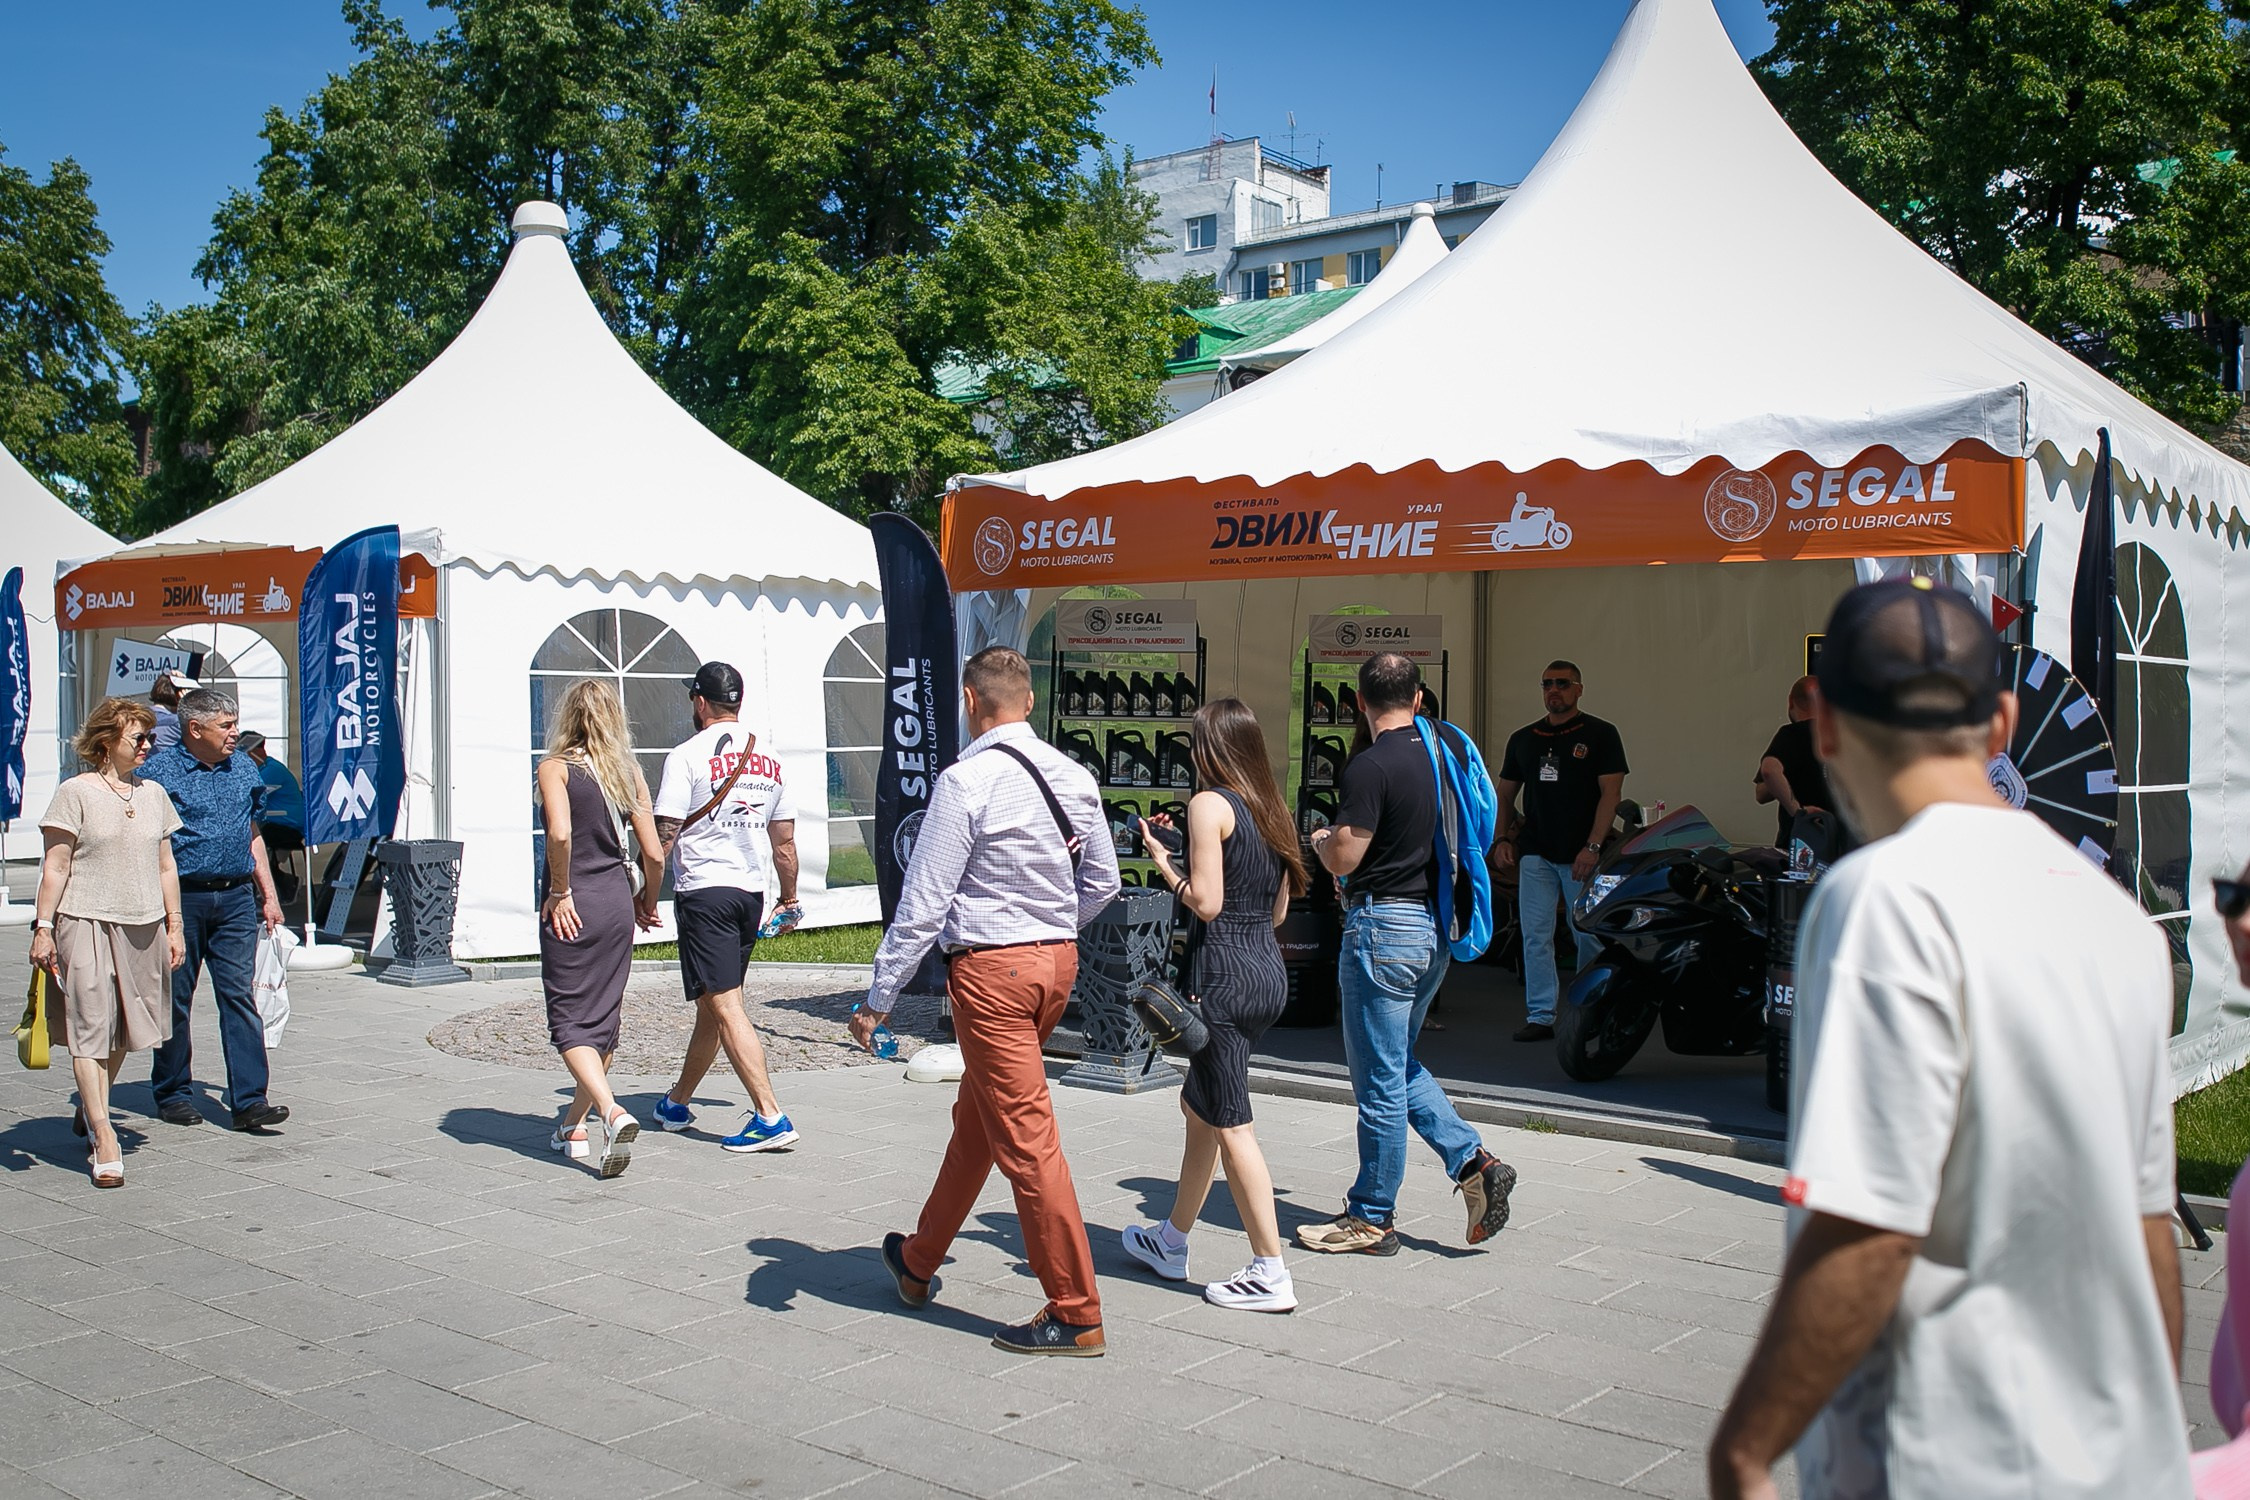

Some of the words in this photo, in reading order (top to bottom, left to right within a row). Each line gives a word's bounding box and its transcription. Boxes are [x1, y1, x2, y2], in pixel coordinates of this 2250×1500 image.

[1785, 463, 1956, 510] SEGAL
[1213, 498, 1280, 510] ФЕСТИВАЛЬ
[1407, 503, 1443, 514] УРАЛ
[1788, 516, 1839, 532] MOTO
[1842, 512, 1952, 530] LUBRICANTS
[1019, 516, 1116, 550] SEGAL
[1020, 556, 1050, 568] MOTO
[1051, 553, 1115, 567] LUBRICANTS
[1209, 557, 1241, 566] МУЗЫКА,
[1243, 556, 1268, 564] СПОРТ
[1275, 553, 1333, 563] МОТОКУЛЬТУРА
[86, 590, 135, 610] BAJAJ
[1115, 612, 1163, 624] SEGAL
[1364, 627, 1410, 638] SEGAL
[136, 656, 180, 672] BAJAJ
[335, 593, 362, 749] BAJAJ
[363, 591, 381, 746] MOTORCYCLES
[923, 658, 937, 749] LUBRICANTS
[892, 657, 927, 800] SEGAL
